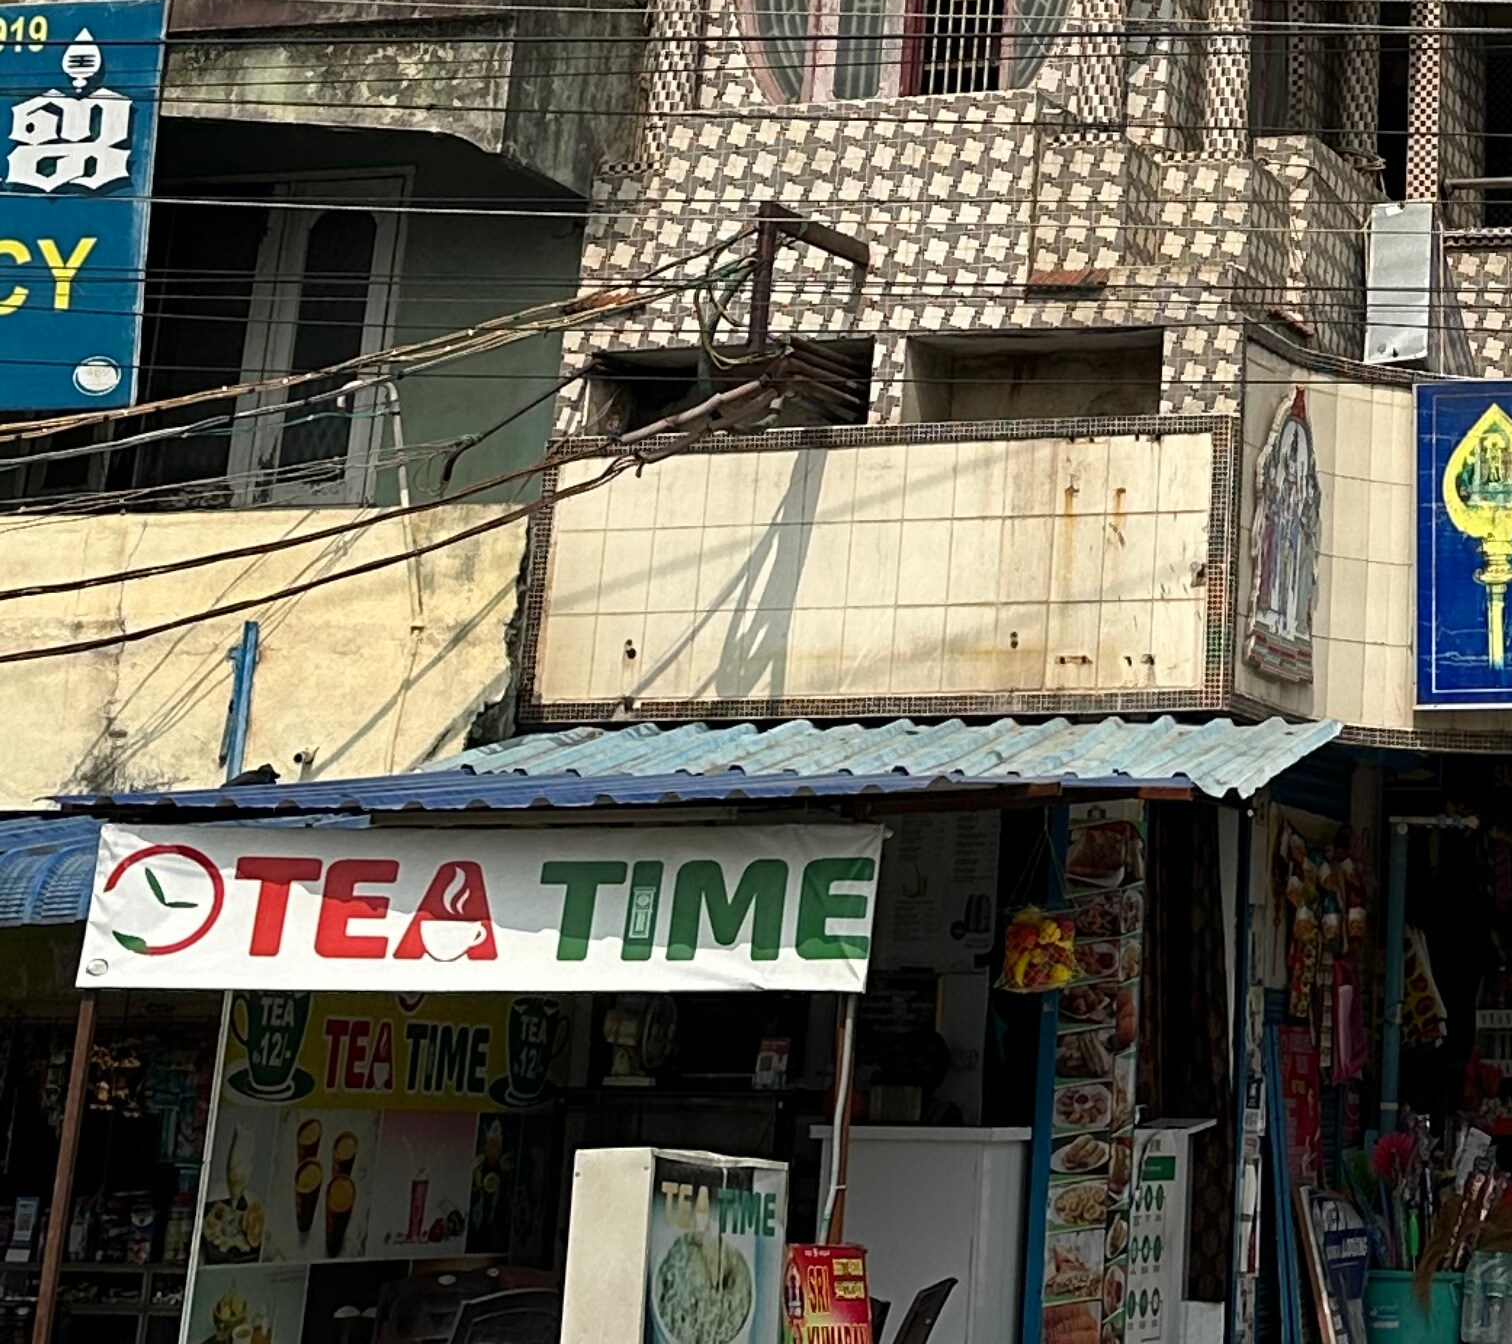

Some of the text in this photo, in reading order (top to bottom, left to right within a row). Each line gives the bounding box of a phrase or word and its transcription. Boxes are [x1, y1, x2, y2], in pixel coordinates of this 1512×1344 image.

[234, 858, 497, 961] TEA
[540, 858, 876, 961] TIME
[261, 997, 294, 1027] TEA
[520, 1015, 547, 1044] TEA
[324, 1016, 490, 1095] TEA TIME
[661, 1180, 776, 1238] TEA TIME
